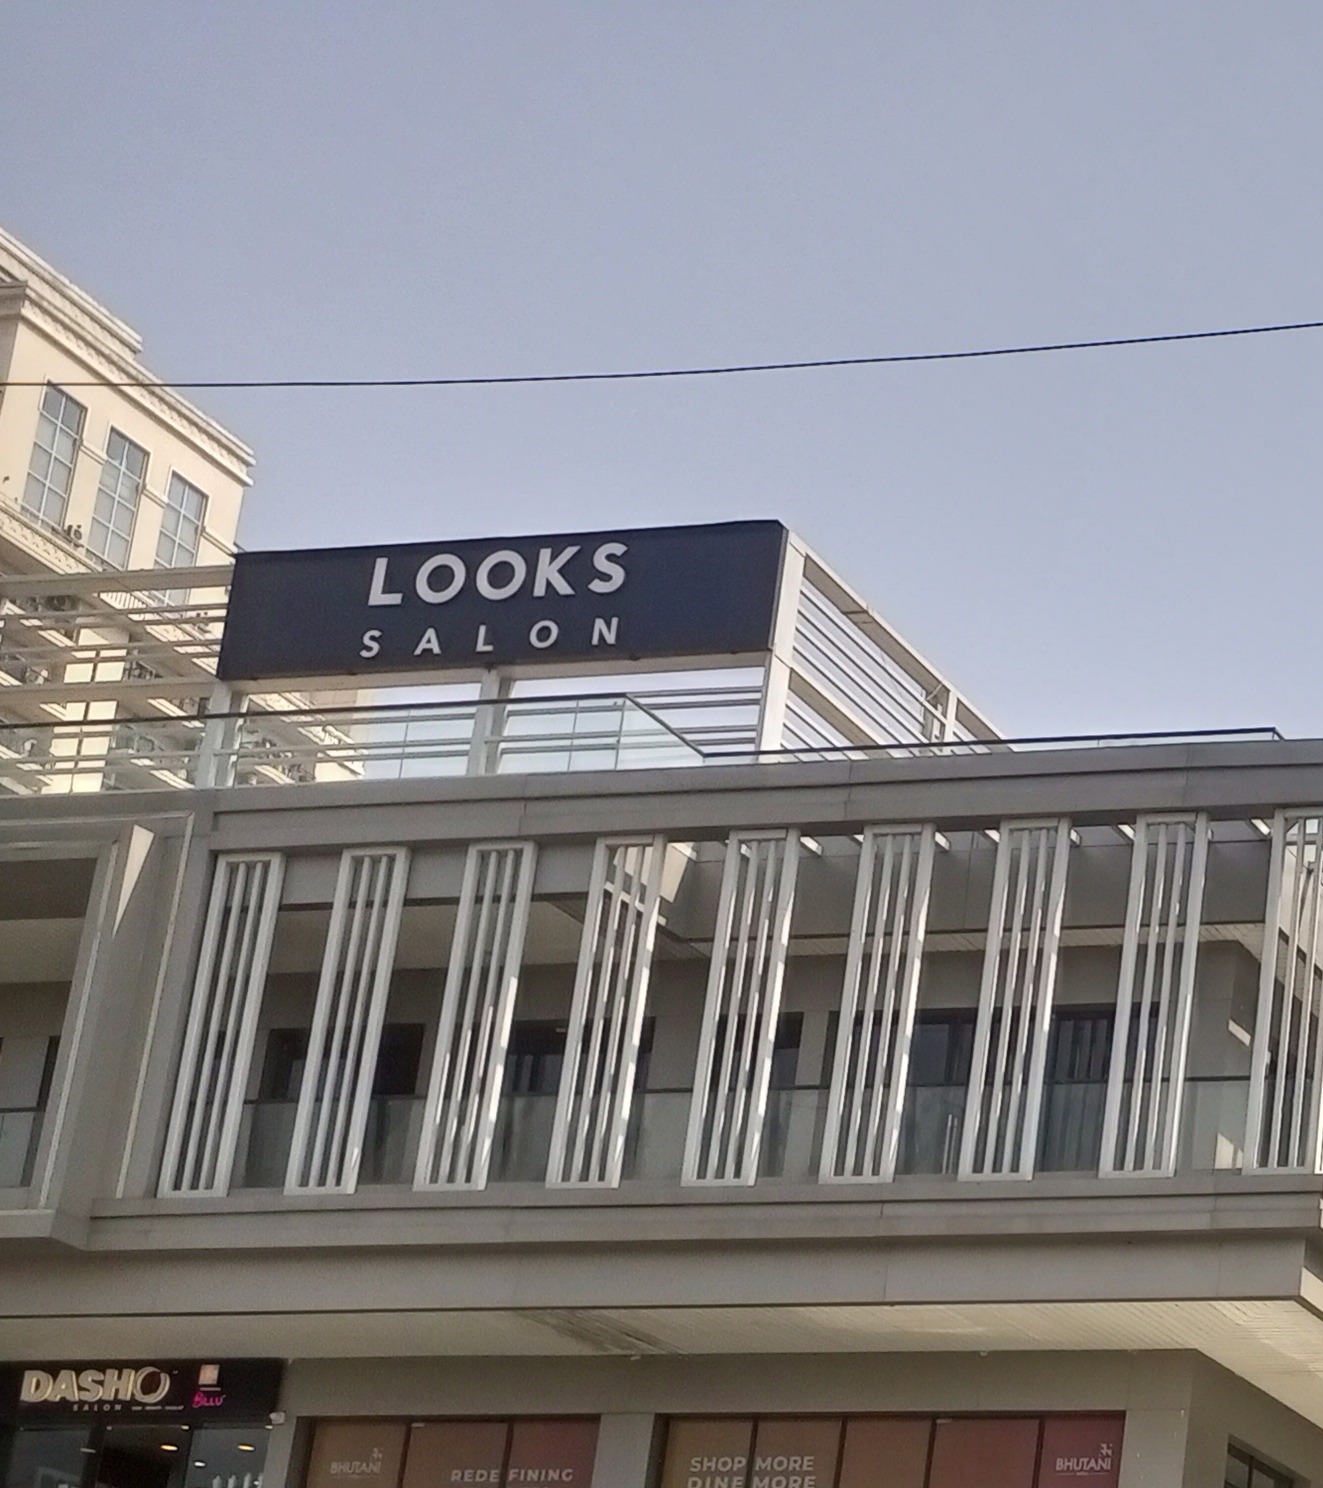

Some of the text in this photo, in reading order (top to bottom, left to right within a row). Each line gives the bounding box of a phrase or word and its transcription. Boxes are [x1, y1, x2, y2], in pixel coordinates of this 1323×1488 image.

[367, 541, 629, 606] LOOKS
[360, 616, 619, 659] SALON
[20, 1366, 170, 1403] DASHO
[73, 1404, 122, 1412] SALON
[330, 1461, 381, 1474] BHUTANI
[690, 1455, 815, 1472] SHOP MORE
[1055, 1457, 1111, 1471] BHUTANI
